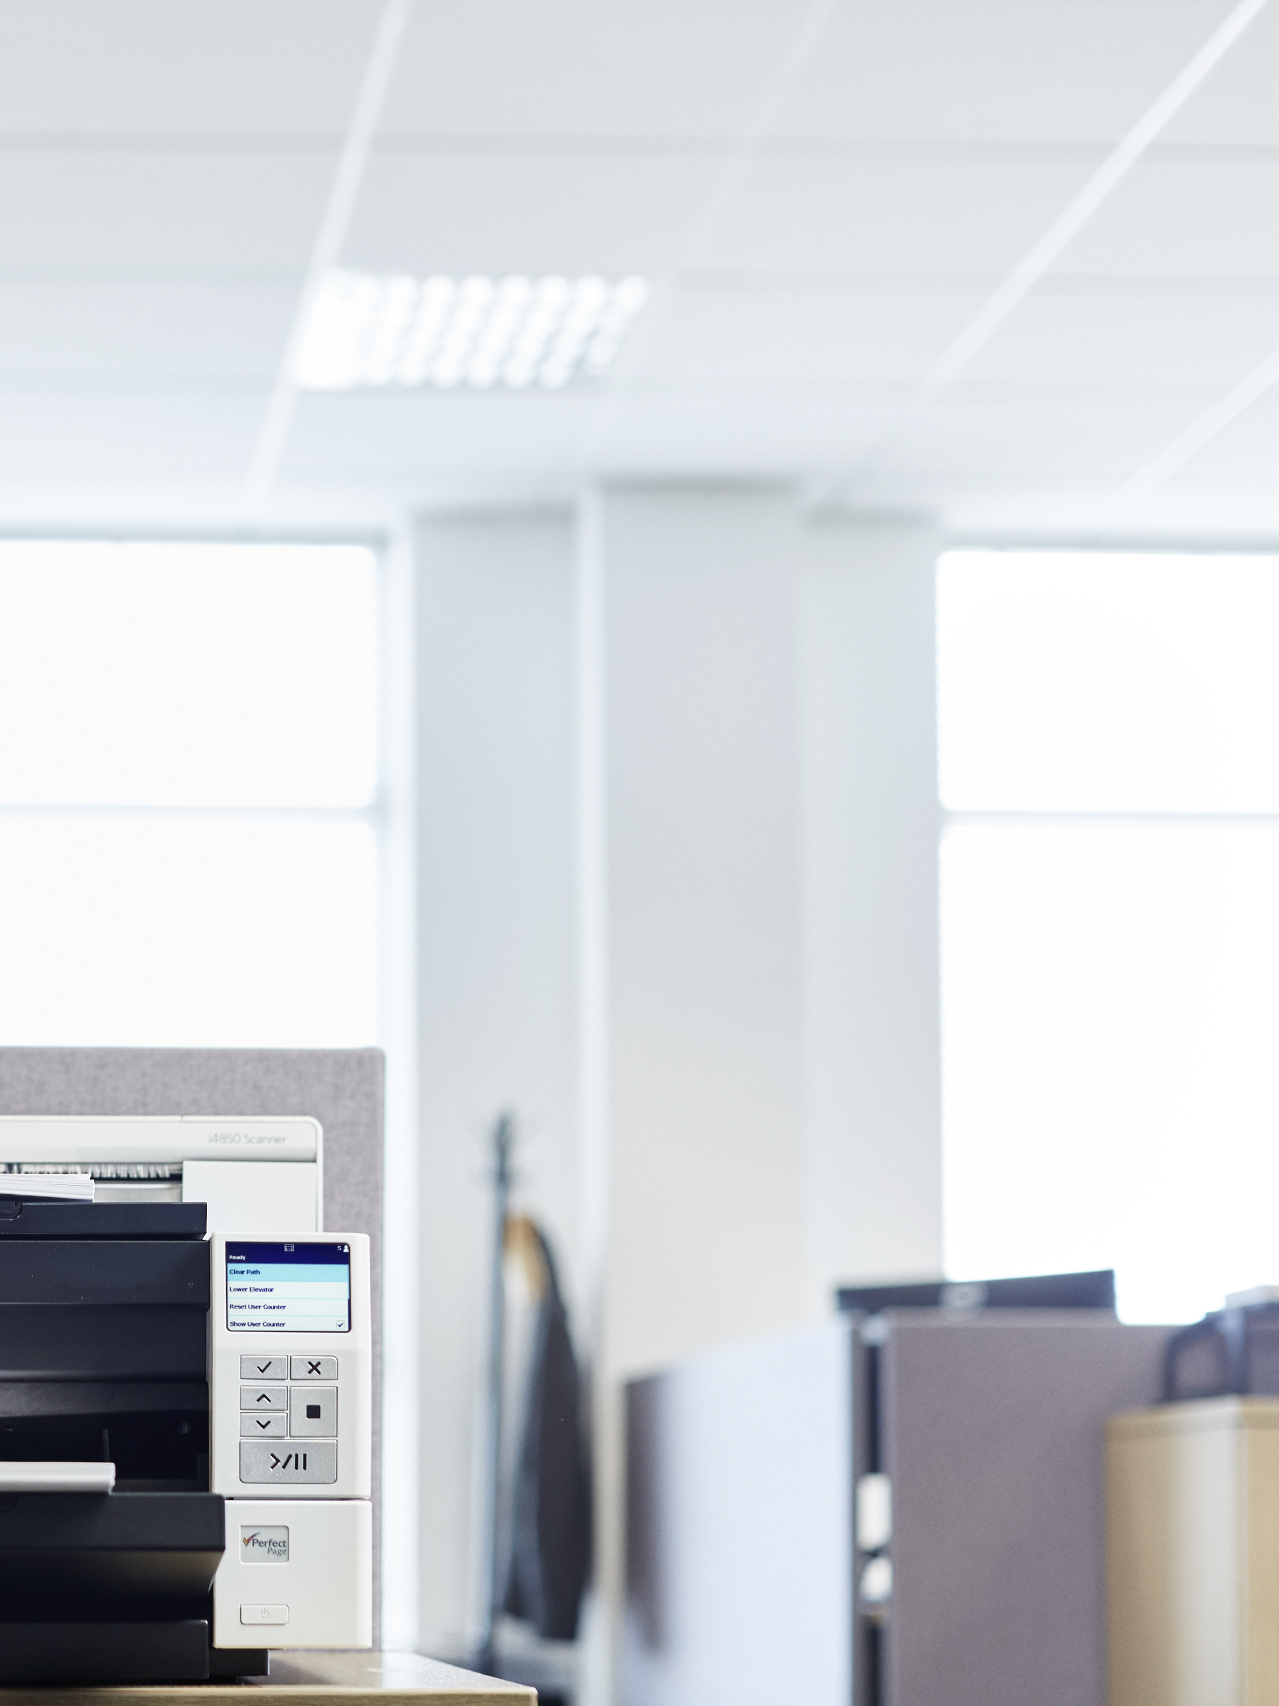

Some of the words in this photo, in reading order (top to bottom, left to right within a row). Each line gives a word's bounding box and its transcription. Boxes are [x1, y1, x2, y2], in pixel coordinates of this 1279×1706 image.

[208, 1133, 241, 1145] i4850
[243, 1133, 286, 1145] Scanner
[251, 1538, 287, 1548] Perfect
[267, 1547, 287, 1557] Page
